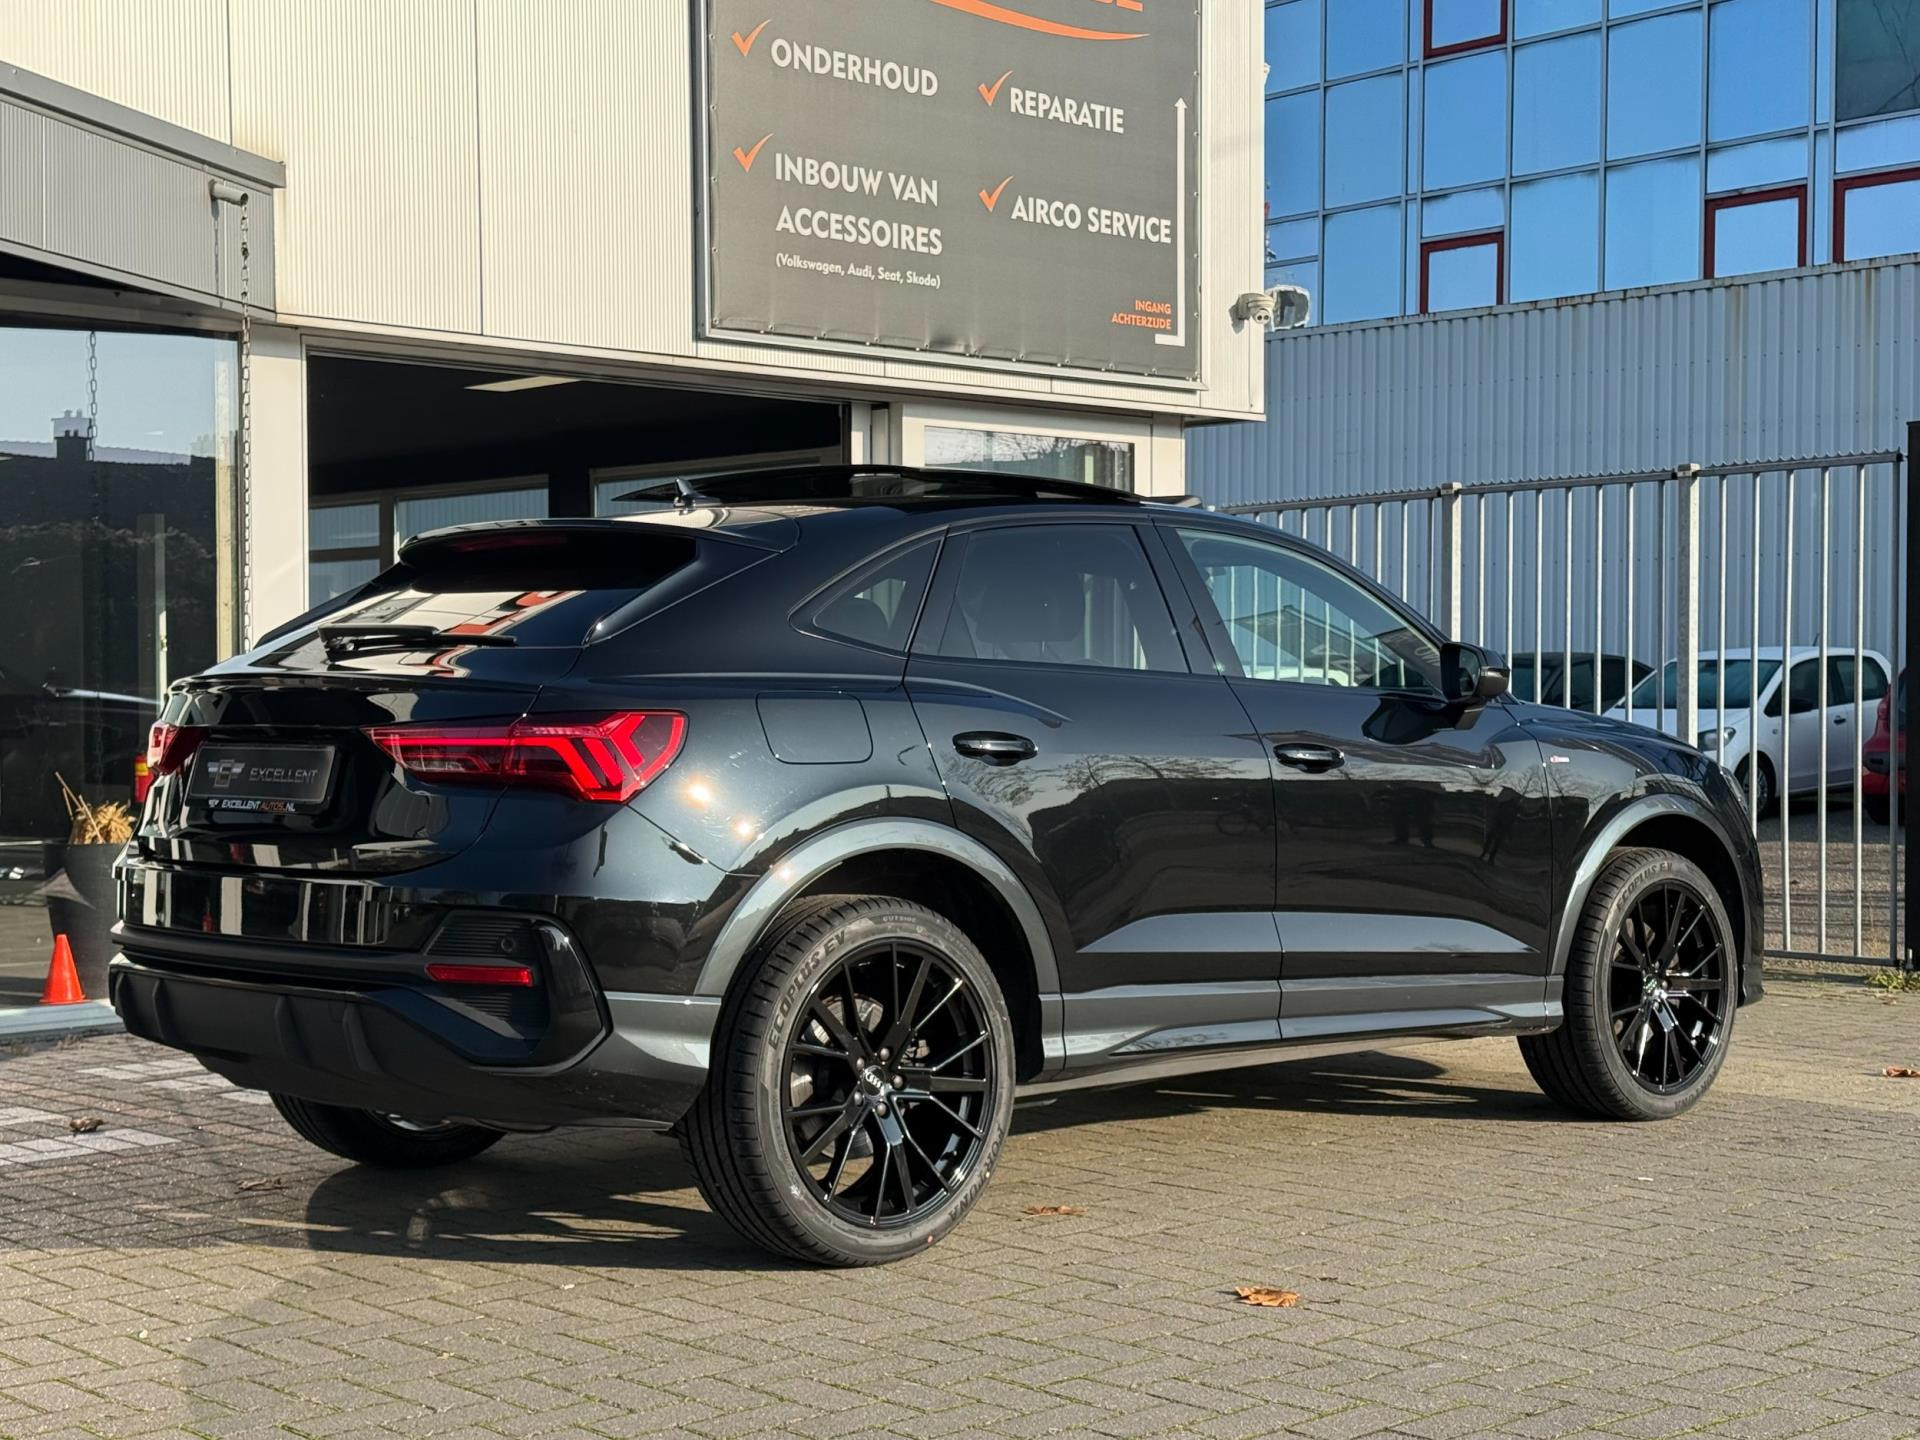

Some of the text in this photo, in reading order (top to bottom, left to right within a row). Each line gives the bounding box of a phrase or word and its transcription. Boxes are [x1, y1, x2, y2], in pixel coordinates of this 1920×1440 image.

[771, 38, 938, 96] ONDERHOUD
[1010, 87, 1124, 134] REPARATIE
[775, 152, 938, 207] INBOUW VAN
[775, 205, 943, 255] ACCESSOIRES
[1011, 195, 1172, 244] AIRCO SERVICE
[775, 252, 941, 289] (Volkswagen, Audi, Seat, Skoda)
[1135, 299, 1171, 314] INGANG
[248, 767, 318, 784] EXCELLENT
[767, 930, 845, 1050] ECOPLUS EV
